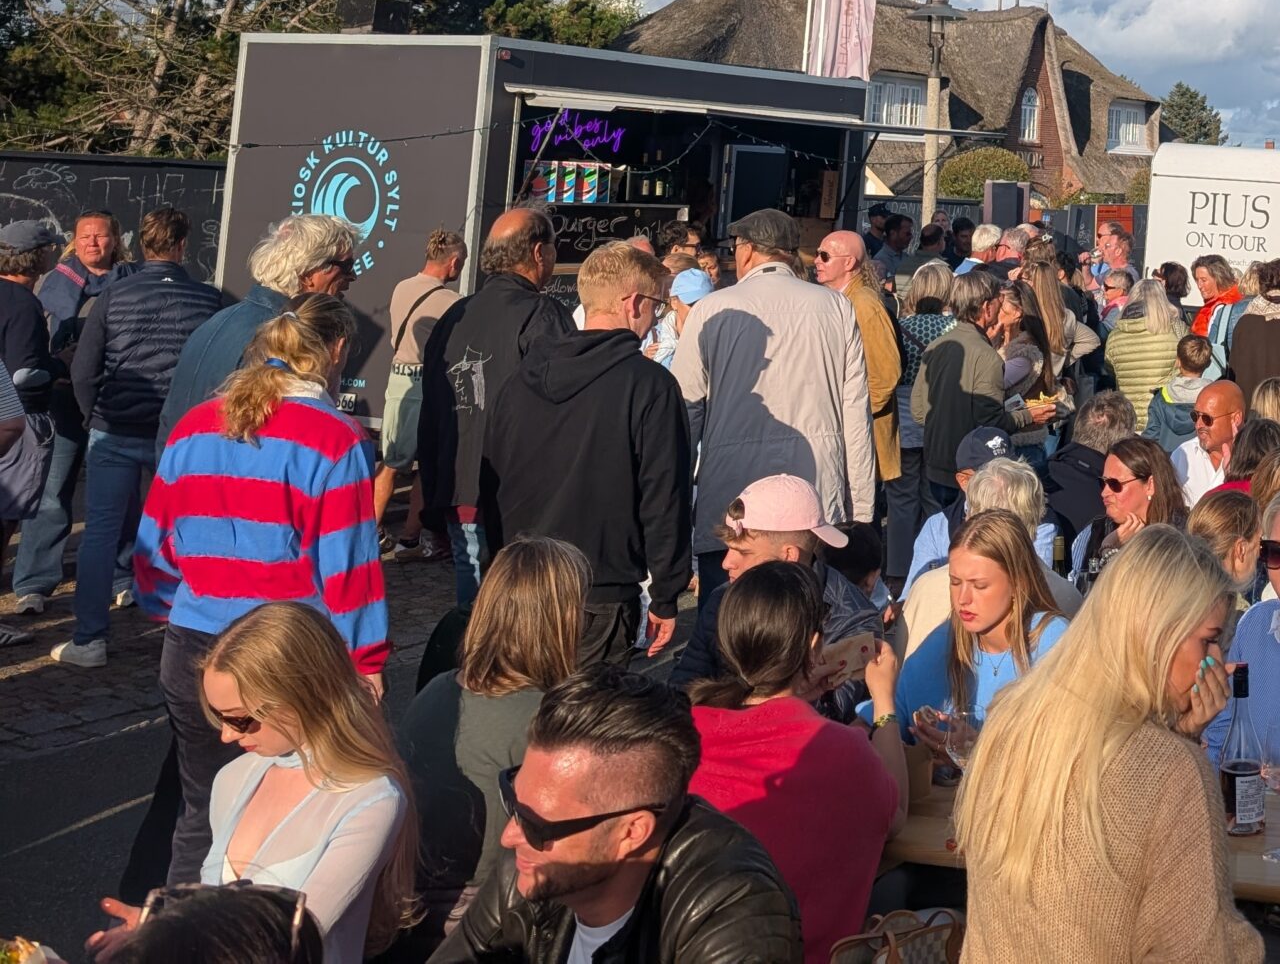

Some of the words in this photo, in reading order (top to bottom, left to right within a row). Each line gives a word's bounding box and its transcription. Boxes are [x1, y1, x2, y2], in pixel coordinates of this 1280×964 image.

[531, 108, 570, 152] god
[582, 120, 627, 153] only
[322, 130, 389, 167] KULTUR
[384, 170, 400, 232] SYLT
[1187, 191, 1270, 230] PIUS
[1186, 231, 1214, 249] ON
[1219, 234, 1267, 253] TOUR
